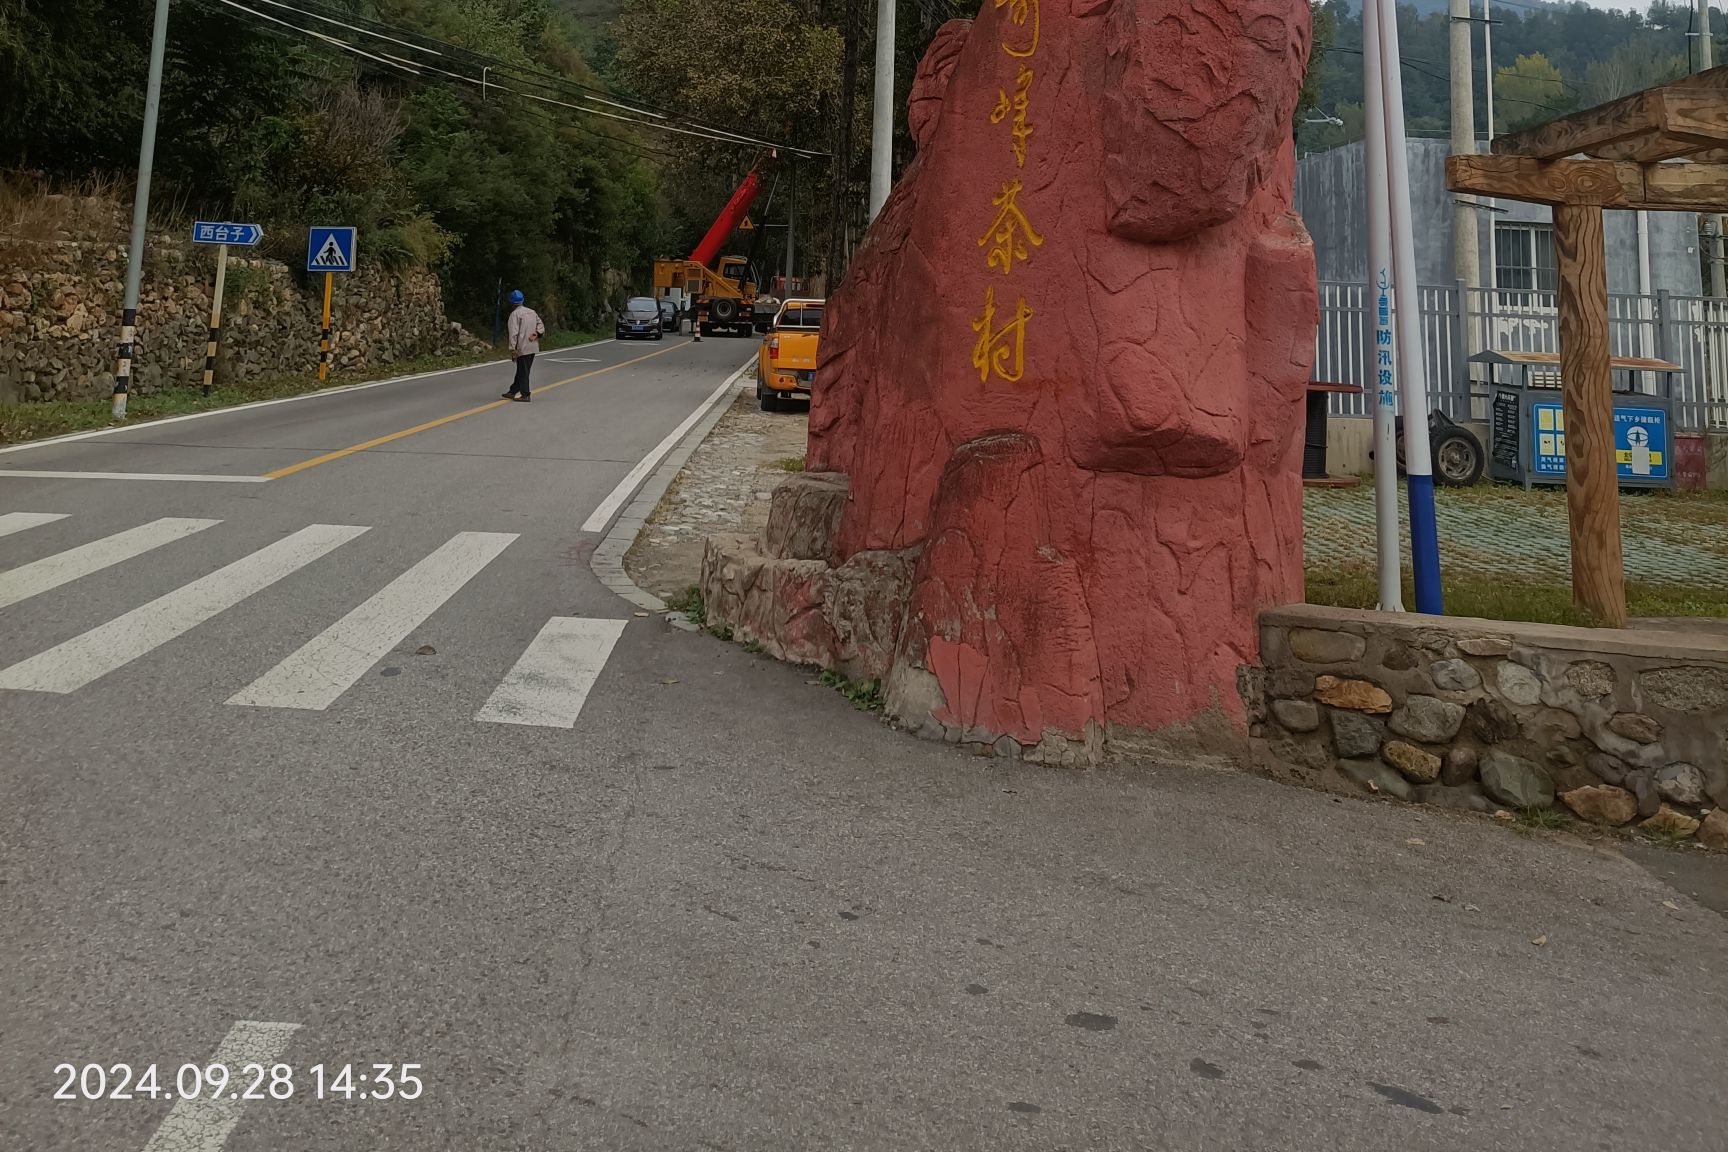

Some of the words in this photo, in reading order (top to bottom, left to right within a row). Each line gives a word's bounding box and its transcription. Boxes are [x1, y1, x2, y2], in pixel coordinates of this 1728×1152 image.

[200, 225, 244, 241] 西台子
[1376, 329, 1394, 407] 防汛设施
